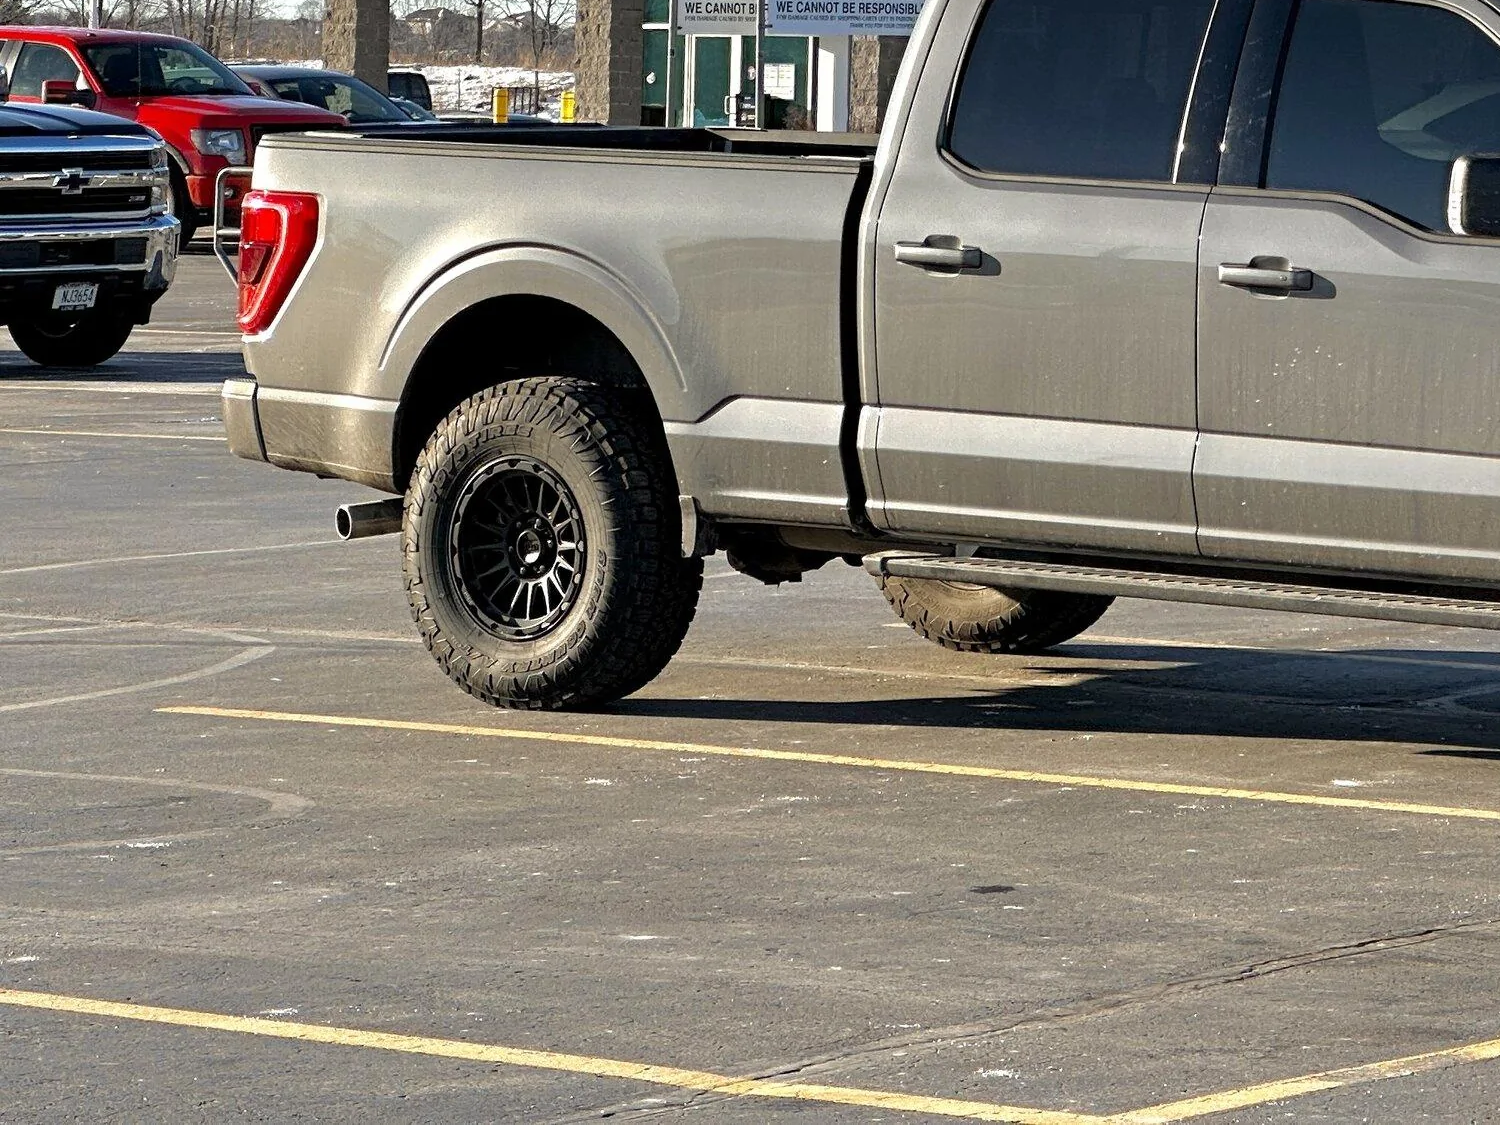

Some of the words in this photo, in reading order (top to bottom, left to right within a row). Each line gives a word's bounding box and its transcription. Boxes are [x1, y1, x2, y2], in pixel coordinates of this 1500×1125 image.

[685, 2, 702, 14] WE
[705, 2, 747, 14] CANNOT
[749, 3, 757, 15] B
[776, 1, 793, 13] WE
[796, 1, 840, 13] CANNOT
[842, 2, 856, 14] BE
[858, 2, 924, 15] RESPONSIBL
[468, 423, 534, 448] TIRES
